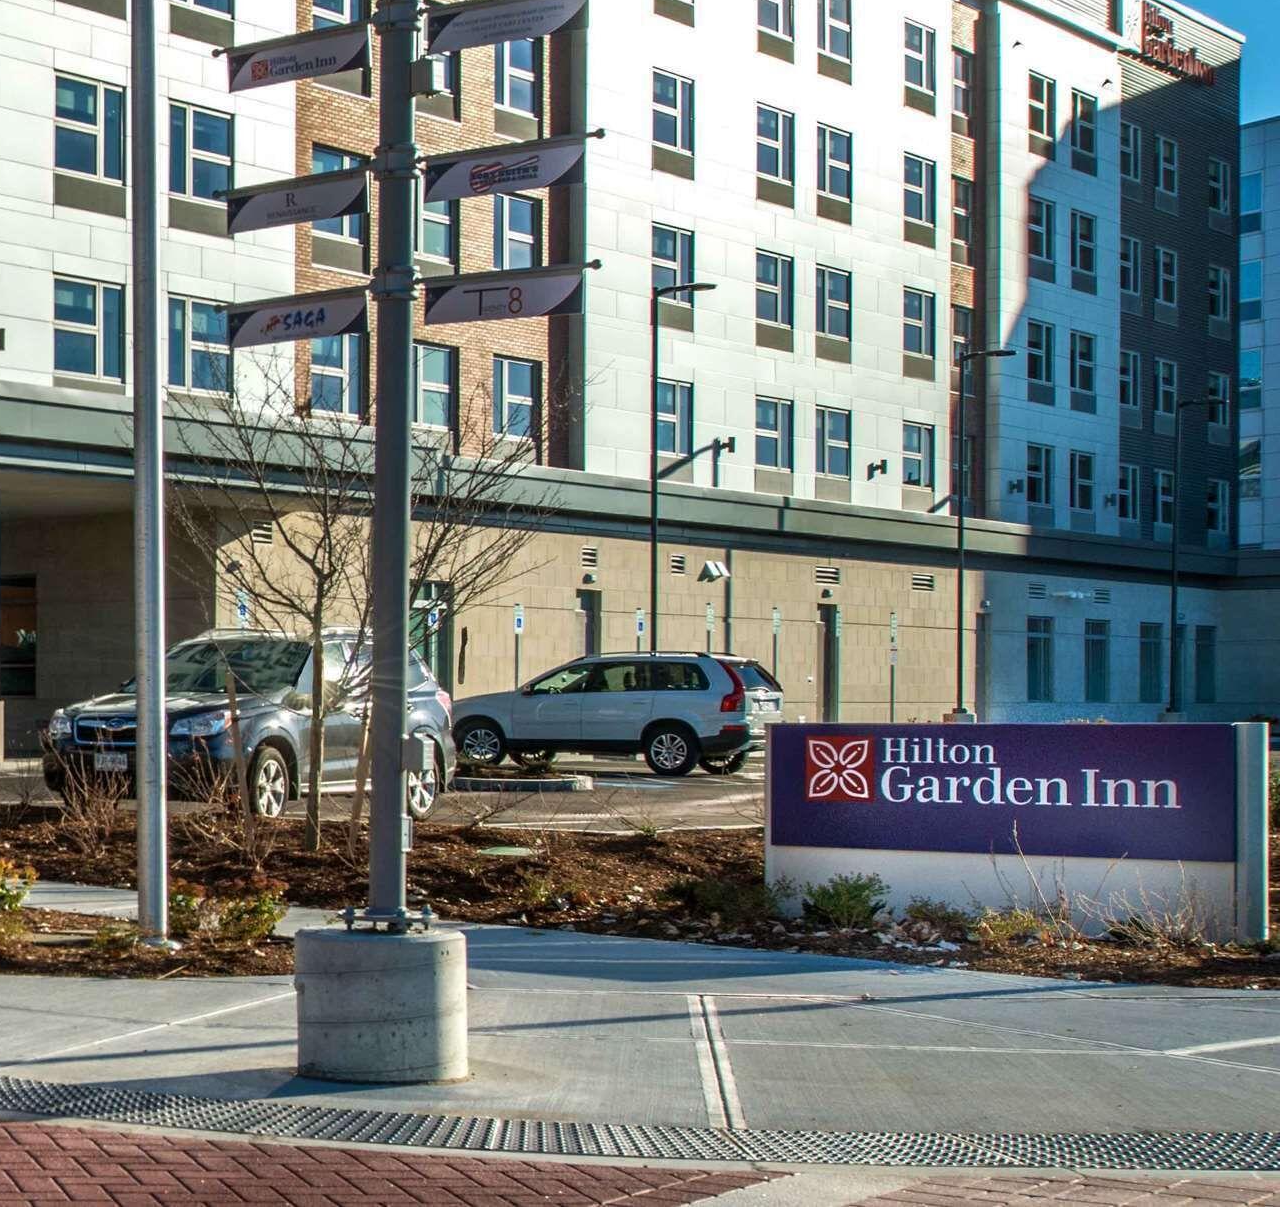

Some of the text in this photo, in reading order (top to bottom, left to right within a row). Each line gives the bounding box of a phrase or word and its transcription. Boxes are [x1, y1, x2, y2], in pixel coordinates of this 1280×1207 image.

[269, 56, 337, 76] Garden Inn
[285, 193, 298, 207] R
[283, 308, 326, 331] SAGA
[881, 737, 998, 765] Hilton
[880, 765, 1182, 809] Garden Inn
